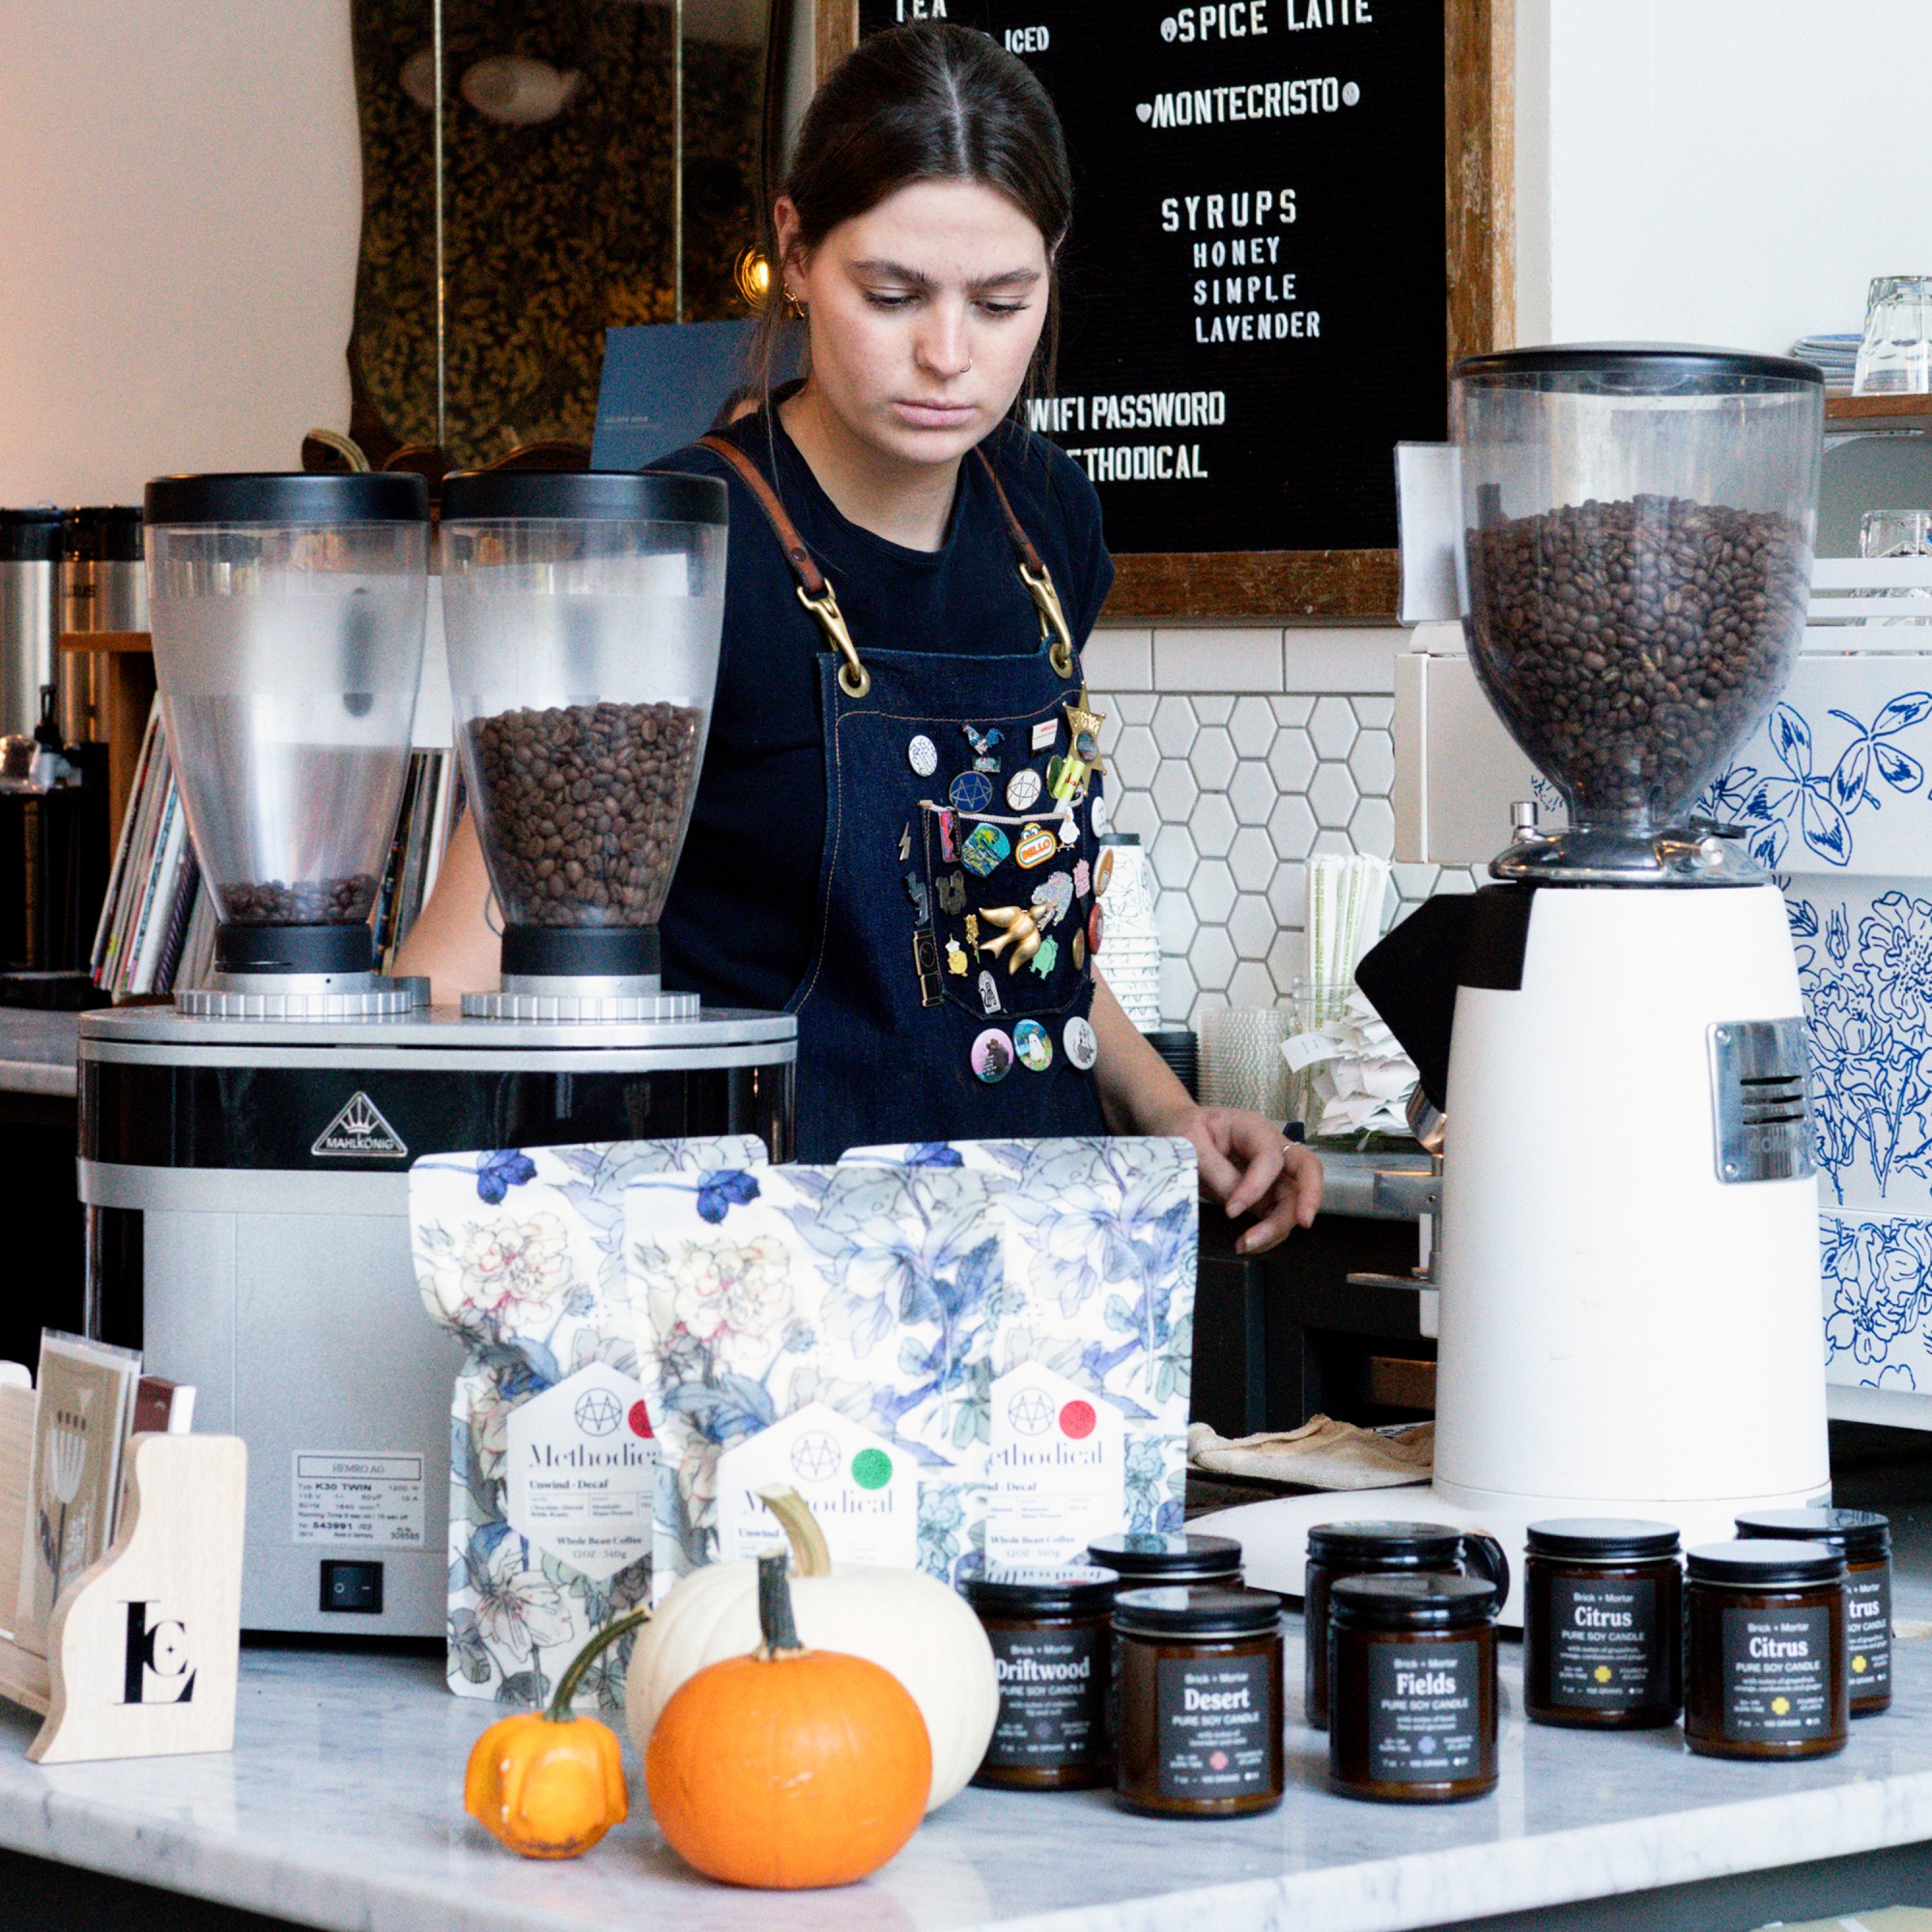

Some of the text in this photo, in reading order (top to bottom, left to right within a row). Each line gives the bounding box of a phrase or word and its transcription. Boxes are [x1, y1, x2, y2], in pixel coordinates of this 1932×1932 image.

[1178, 0, 1373, 43] SPICE LATTE
[1005, 26, 1050, 54] ICED
[1151, 77, 1339, 128] MONTECRISTO
[1161, 188, 1296, 232] SYRUPS
[1193, 236, 1280, 269] HONEY
[1193, 273, 1296, 305] SIMPLE
[1195, 310, 1321, 344] LAVENDER
[1027, 390, 1226, 432] WIFI PASSWORD
[326, 1137, 394, 1150] MAHLKÖNIG
[529, 1479, 609, 1490] Unwind Decaf
[1007, 1482, 1037, 1492] Decaf
[557, 1536, 642, 1545] Whole Bean Coffee
[1573, 1591, 1596, 1603] Brick
[1605, 1593, 1634, 1603] Mortar
[1575, 1605, 1633, 1627] Citrus
[1561, 1630, 1645, 1641] PURE SOY CANDLE
[1747, 1623, 1772, 1633] Brick
[1780, 1623, 1809, 1633] Mortar
[1748, 1636, 1809, 1658] Citrus
[995, 1656, 1091, 1681] Driftwood
[1735, 1660, 1820, 1673] PURE SOY CANDLE
[1397, 1672, 1457, 1695] Fields
[1184, 1688, 1251, 1711] Desert
[1380, 1697, 1469, 1711] PURE SOY CANDLE
[1172, 1711, 1260, 1726] PURE SOY CANDLE
